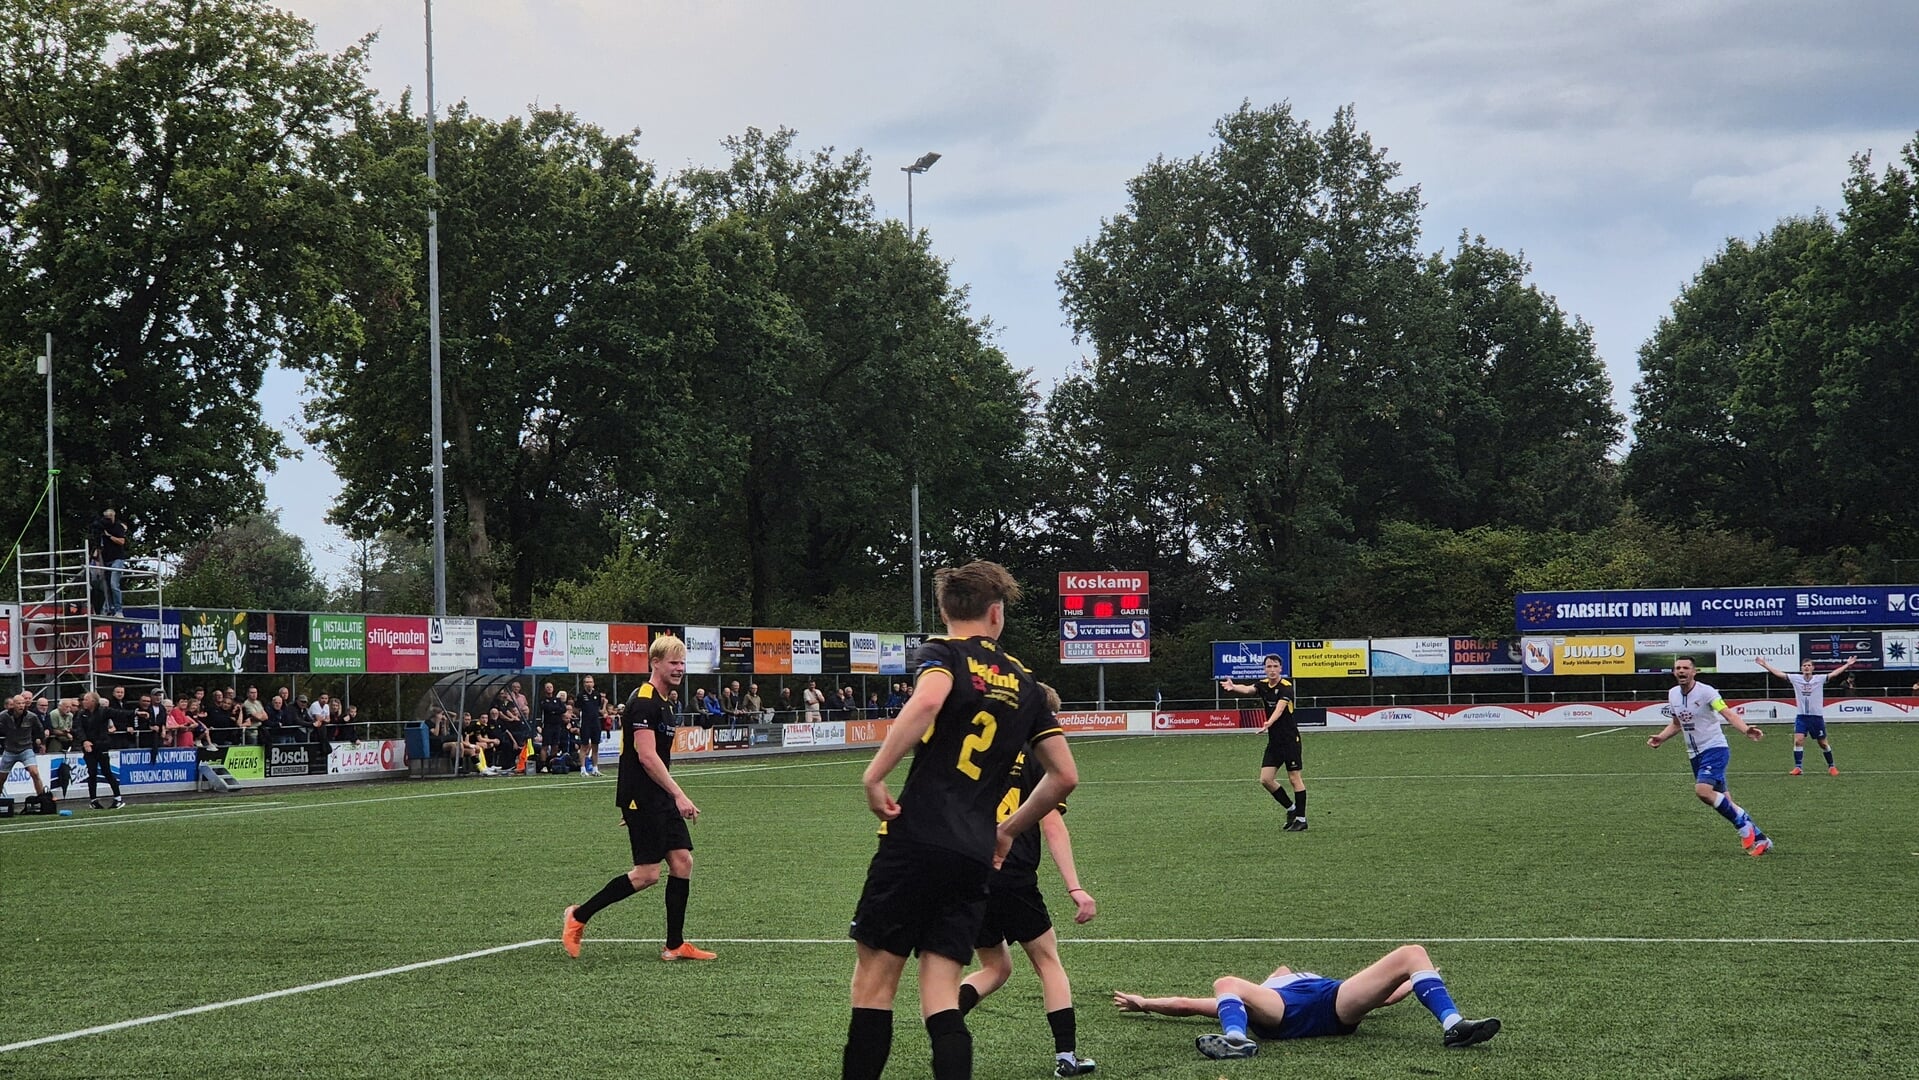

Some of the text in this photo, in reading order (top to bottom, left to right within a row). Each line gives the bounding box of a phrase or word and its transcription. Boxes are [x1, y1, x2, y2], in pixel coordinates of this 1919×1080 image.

[1066, 575, 1142, 591] Koskamp
[1702, 598, 1786, 610] ACCURAAT
[1810, 594, 1866, 606] Stameta
[1557, 602, 1691, 618] STARSELECT DEN HAM
[192, 624, 215, 637] DAGJE
[323, 621, 362, 633] INSTALLATIE
[569, 628, 601, 640] De Hammer
[190, 637, 217, 651] BEERZE
[368, 628, 425, 648] stijlgenoten
[853, 638, 876, 650] KNOBBEN
[145, 642, 176, 658] DEN HAM
[570, 645, 595, 657] Apotheek
[793, 639, 820, 654] SEINE
[1563, 644, 1625, 658] JUMBO
[1721, 644, 1794, 656] Bloemendal
[315, 657, 361, 667] DUURZAAM BEZIG
[1222, 654, 1247, 663] Klaas
[1455, 653, 1491, 662] DOEN?
[852, 726, 866, 741] ING
[956, 711, 998, 780] 2
[121, 751, 196, 765] WORDT LID AN SUPPORTERS
[271, 747, 309, 764] Bosch
[342, 752, 379, 766] LA PLAZA
[228, 757, 258, 769] HEIKENS
[130, 768, 187, 783] VERENIGING DEN HAM
